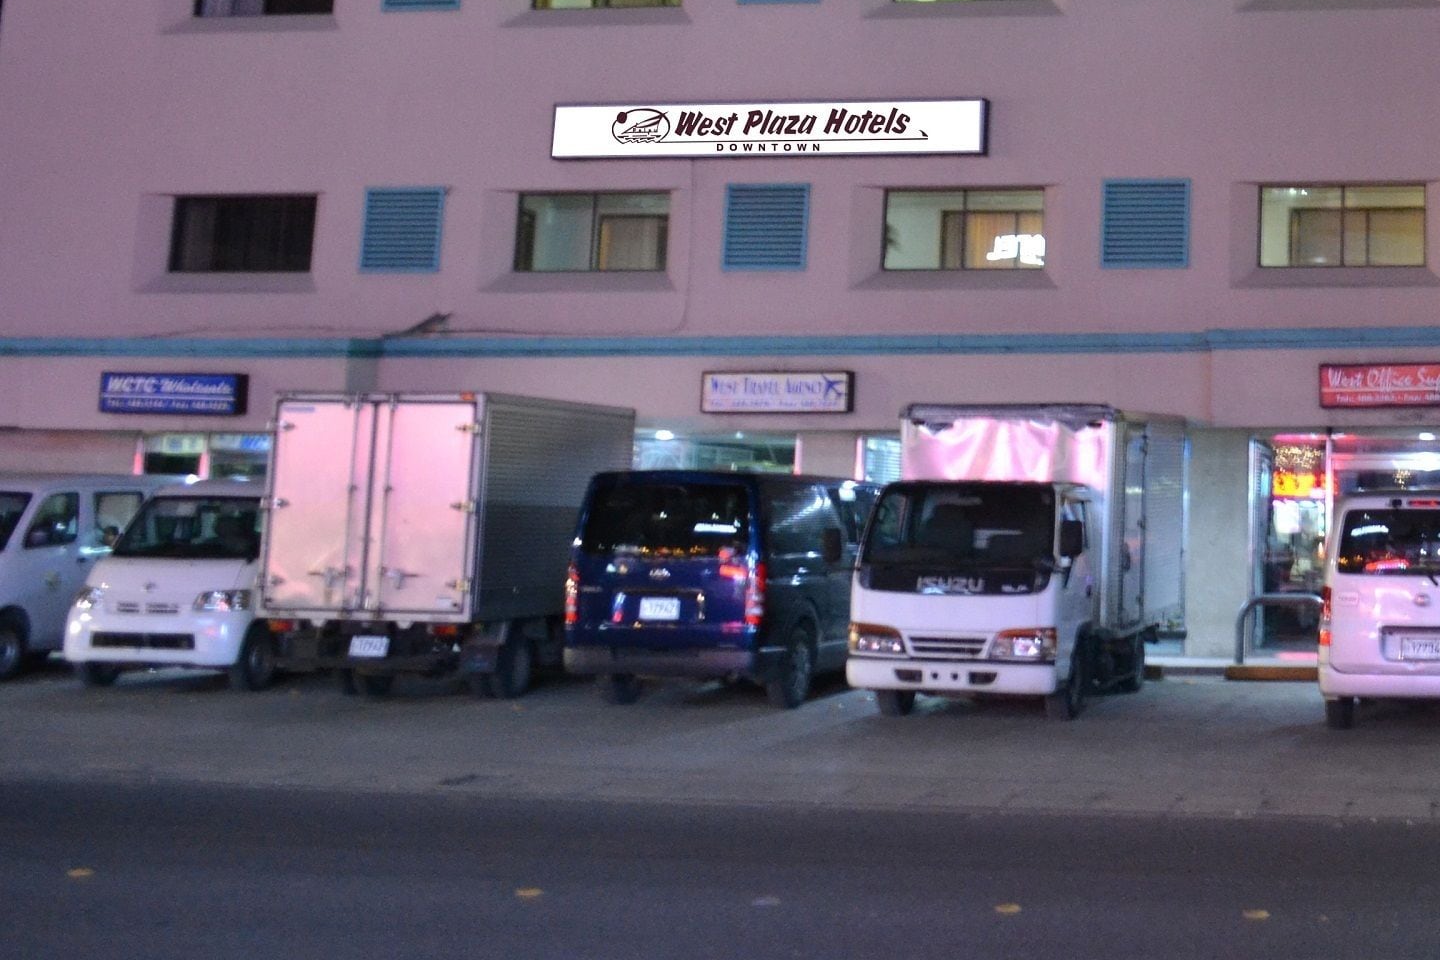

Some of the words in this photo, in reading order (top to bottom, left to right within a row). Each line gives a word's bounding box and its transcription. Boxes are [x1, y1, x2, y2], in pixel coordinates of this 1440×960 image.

[675, 111, 738, 136] West
[743, 110, 817, 135] Plaza
[823, 108, 910, 134] Hotels
[716, 143, 820, 152] DOWNTOWN
[107, 376, 158, 393] WCTC
[1328, 367, 1363, 387] West
[1367, 366, 1412, 392] Office
[916, 576, 985, 593] ISUZU
